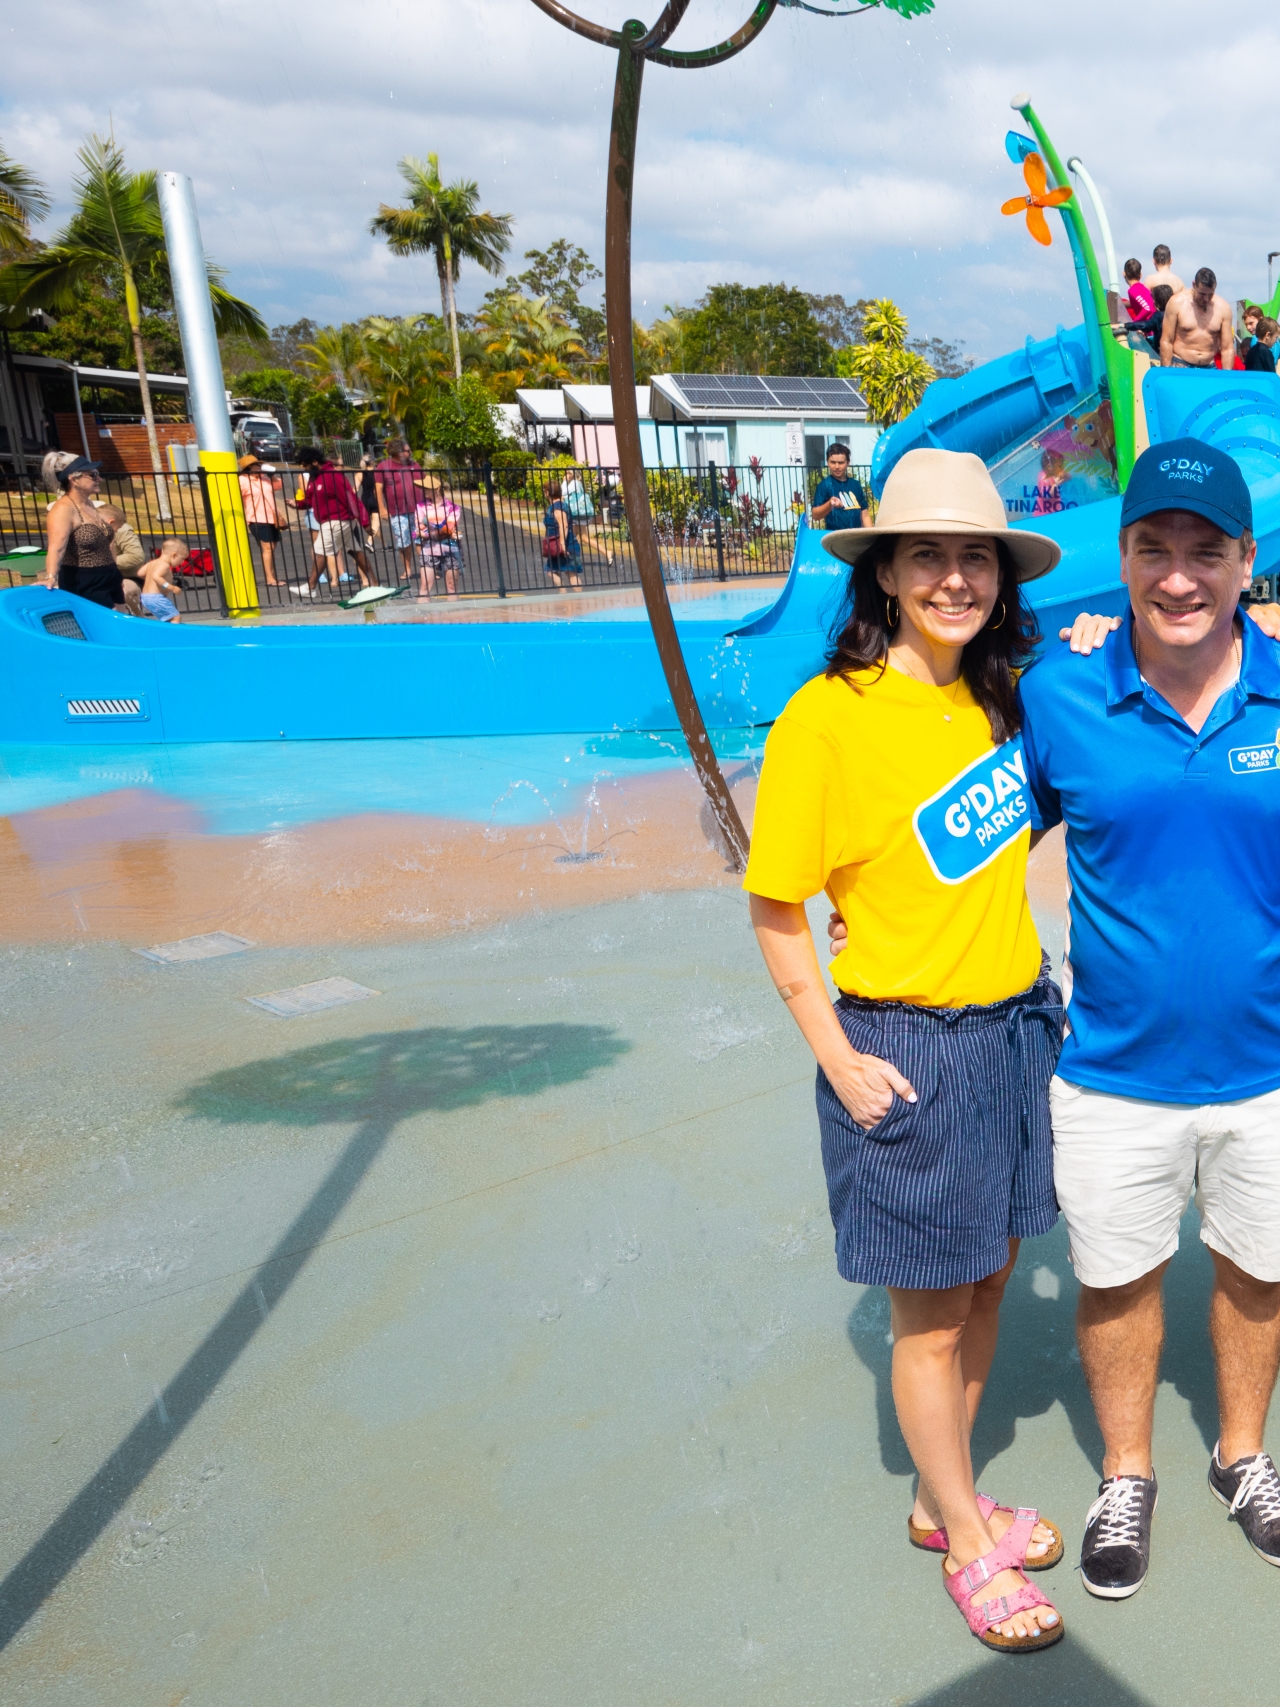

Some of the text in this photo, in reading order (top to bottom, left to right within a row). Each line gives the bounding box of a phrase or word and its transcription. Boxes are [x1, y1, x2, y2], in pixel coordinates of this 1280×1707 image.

[791, 435, 797, 444] 5
[1159, 458, 1214, 476] G'DAY
[1168, 471, 1204, 483] PARKS
[1023, 485, 1062, 498] LAKE
[1237, 748, 1274, 763] G'DAY
[1247, 760, 1270, 768] PARKS
[944, 749, 1028, 837] G'DAY
[974, 794, 1027, 847] PARKS
